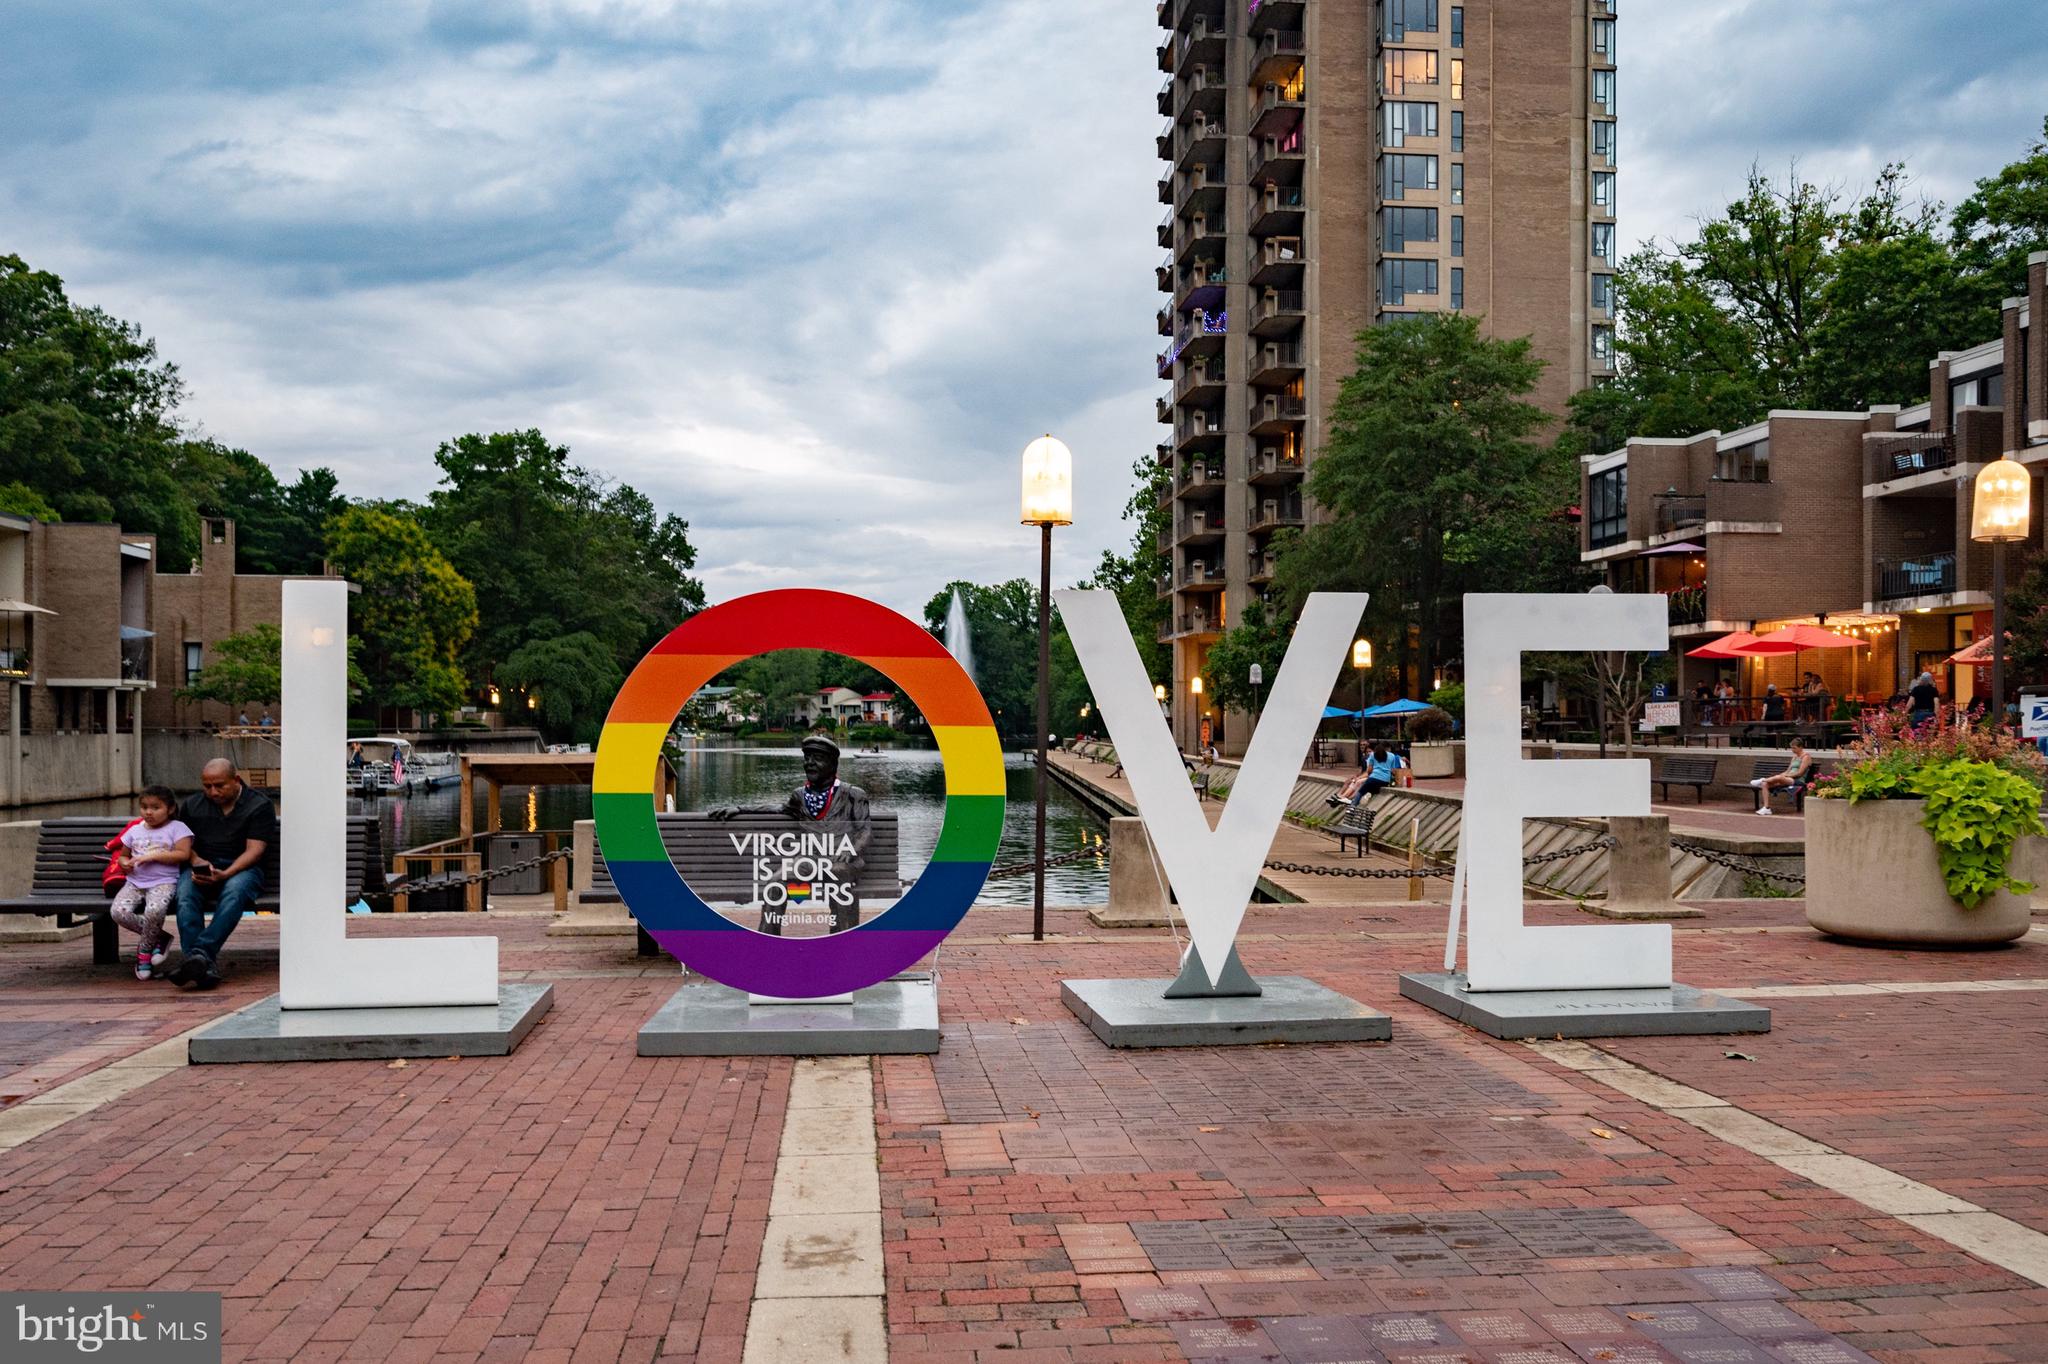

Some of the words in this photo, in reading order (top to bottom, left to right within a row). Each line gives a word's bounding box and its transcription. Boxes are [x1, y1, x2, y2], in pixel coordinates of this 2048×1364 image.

[729, 833, 857, 856] VIRGINIA
[753, 858, 773, 881] IS
[782, 857, 838, 881] FOR
[764, 912, 837, 926] Virginia.org
